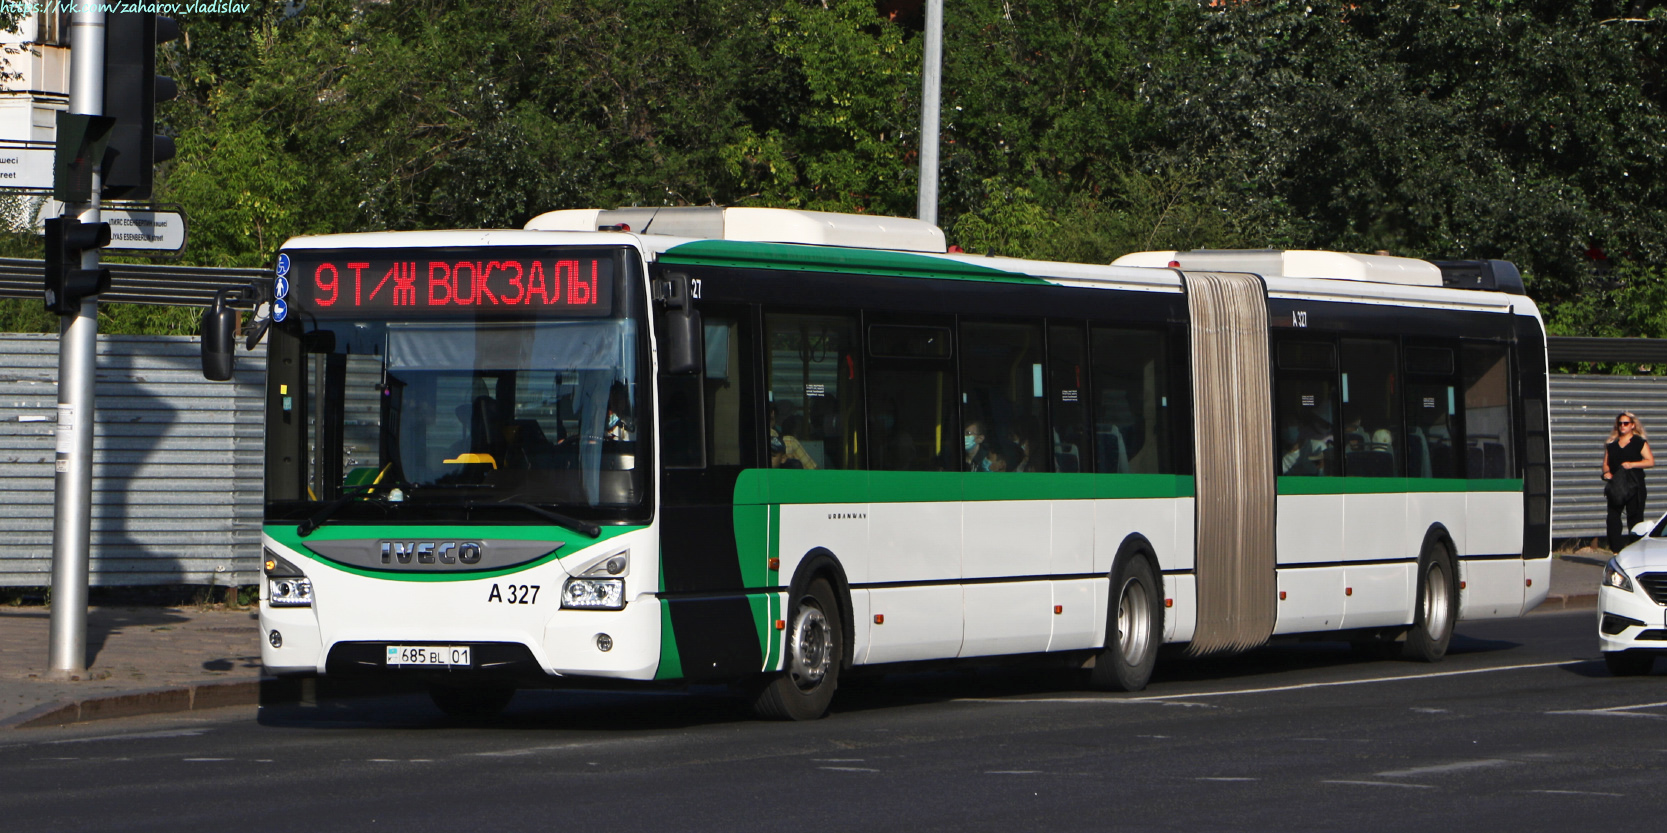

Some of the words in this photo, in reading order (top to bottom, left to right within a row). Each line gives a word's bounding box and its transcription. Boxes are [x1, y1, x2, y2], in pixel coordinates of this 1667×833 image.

[315, 263, 338, 306] 9
[347, 261, 416, 306] Т/Ж
[428, 260, 597, 305] ВОКЗАЛЫ
[691, 279, 701, 298] 27
[381, 541, 482, 565] IVECO
[488, 583, 503, 603] A
[507, 584, 540, 604] 327
[402, 649, 426, 663] 685
[430, 652, 445, 663] BL
[452, 650, 468, 663] 01
